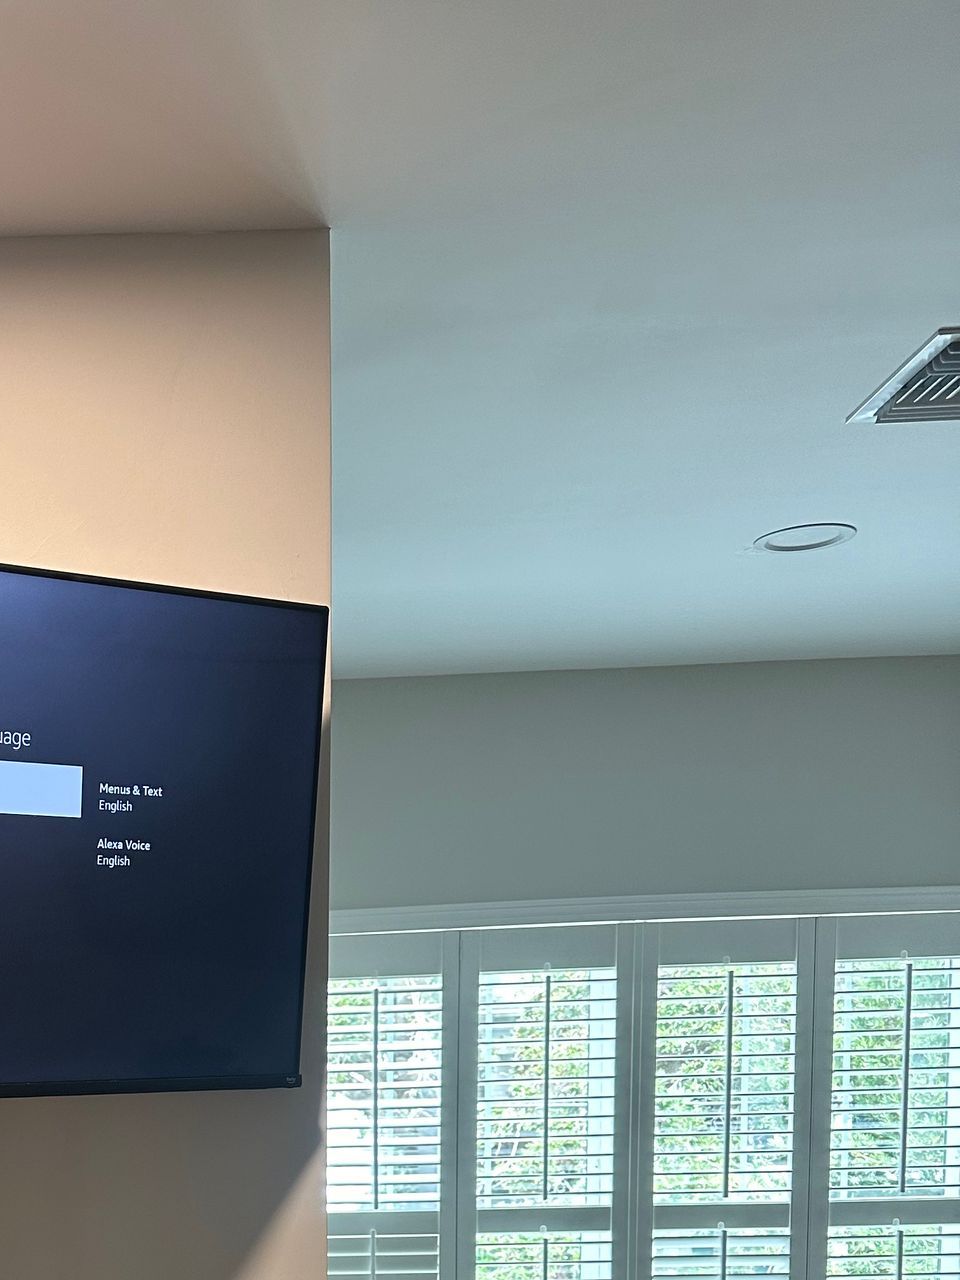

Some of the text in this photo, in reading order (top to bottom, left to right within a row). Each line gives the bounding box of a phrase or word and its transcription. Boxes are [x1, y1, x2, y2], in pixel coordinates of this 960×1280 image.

[99, 783, 163, 797] Menus & Text
[98, 799, 133, 813] English
[97, 838, 151, 851] Alexa Voice
[97, 854, 131, 868] English
